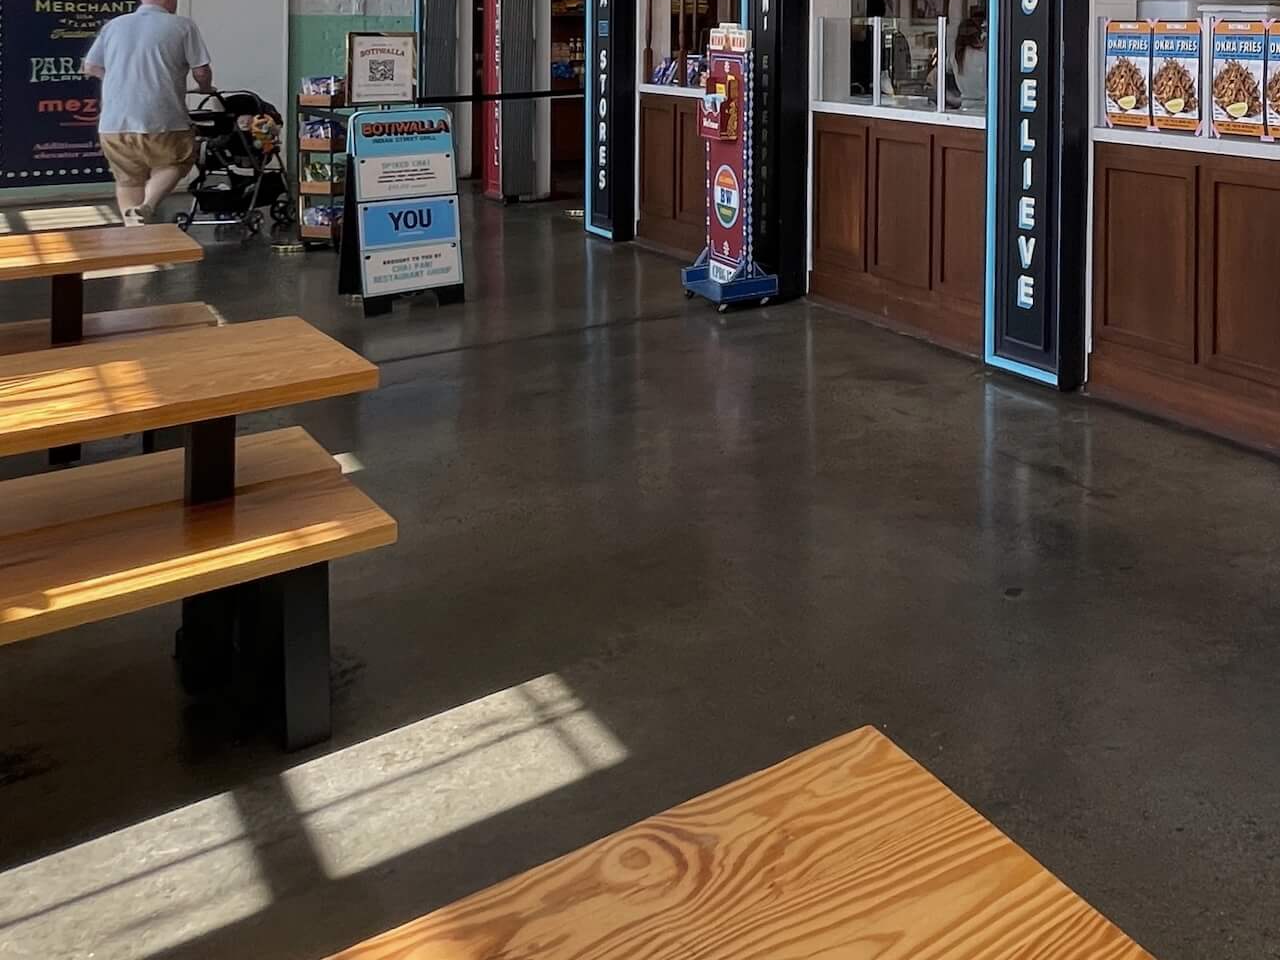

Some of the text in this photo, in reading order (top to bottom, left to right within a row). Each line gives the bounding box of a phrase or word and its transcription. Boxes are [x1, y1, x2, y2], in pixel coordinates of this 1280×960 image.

[35, 0, 137, 13] MERCHANT
[1108, 39, 1149, 50] OKRA FRIES
[1154, 40, 1198, 52] OKRA FRIES
[1215, 41, 1263, 53] OKRA FRIES
[38, 98, 97, 113] mez
[598, 49, 607, 190] STORES
[361, 120, 450, 138] BOTIWALLA
[1016, 40, 1039, 310] BELIEVE
[719, 187, 733, 205] BW
[388, 208, 432, 232] YOU
